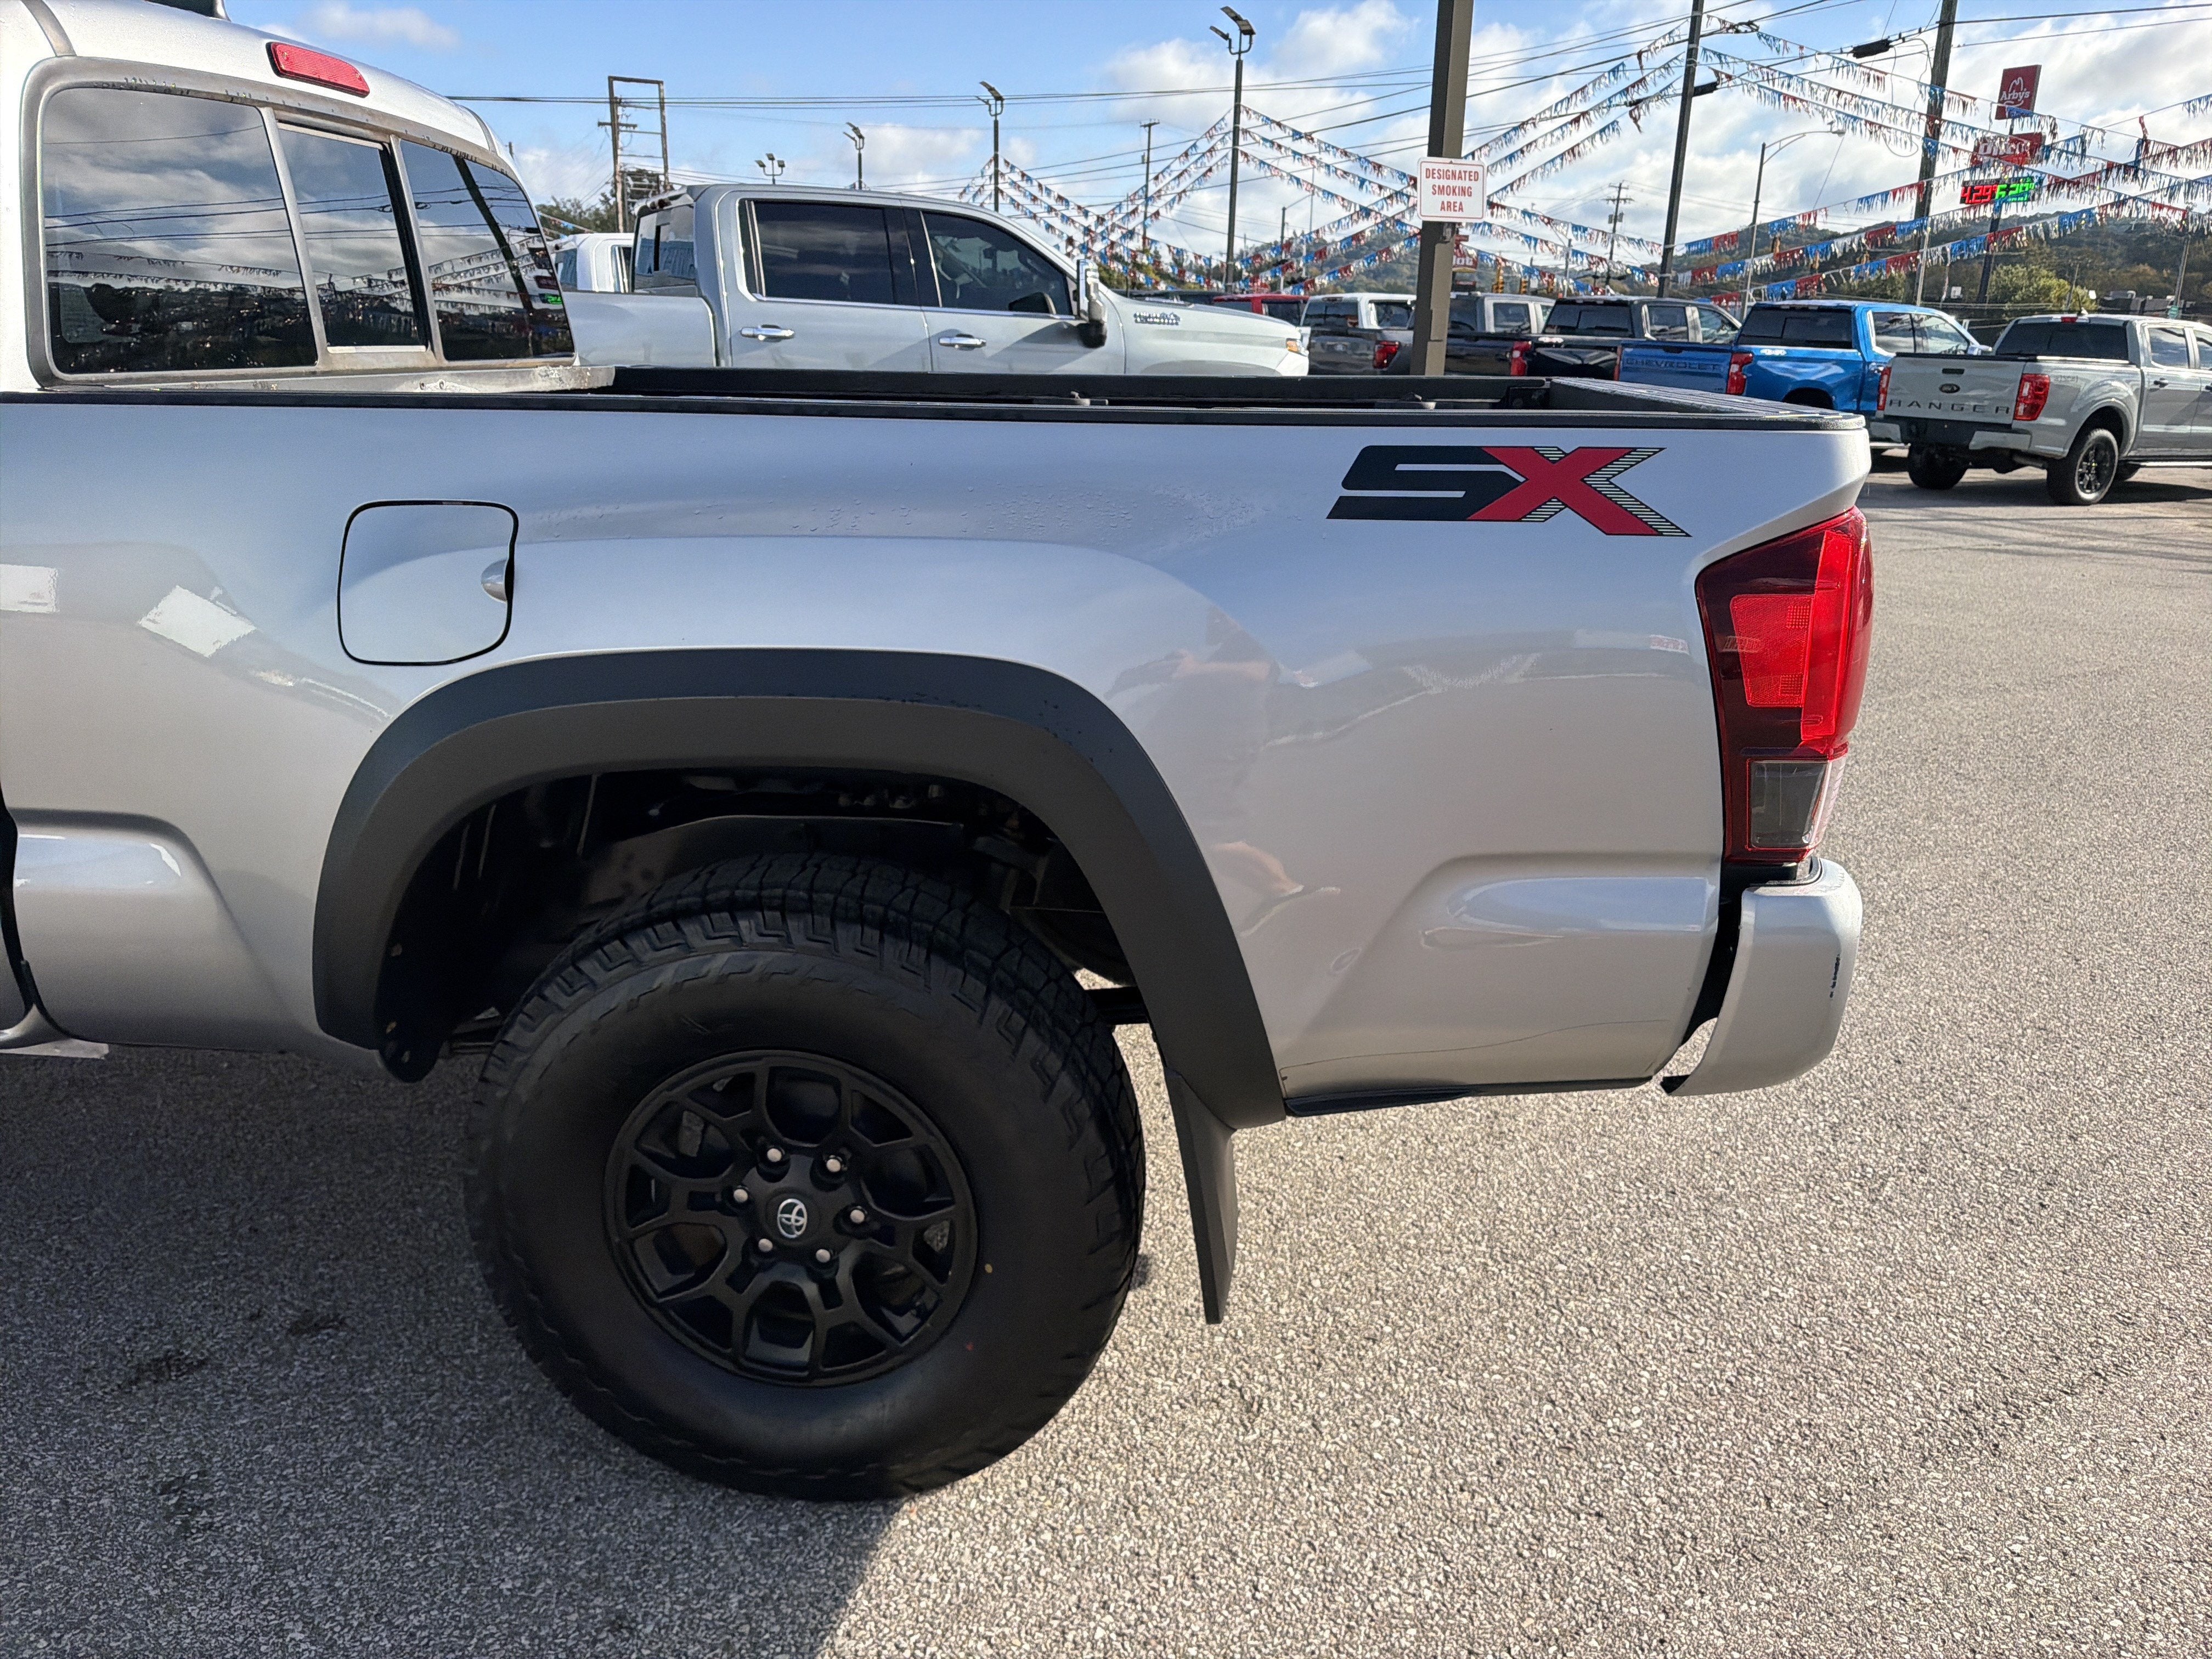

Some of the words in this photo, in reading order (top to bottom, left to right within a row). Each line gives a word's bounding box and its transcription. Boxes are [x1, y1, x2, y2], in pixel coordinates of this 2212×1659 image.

[2000, 88, 2030, 101] Arby's
[1425, 167, 1480, 182] DESIGNATED
[1431, 184, 1472, 197] SMOKING
[1440, 200, 1464, 212] AREA
[1626, 358, 1722, 371] CHEVROLET
[1889, 399, 2010, 415] RANGER
[1326, 445, 1693, 538] SX
